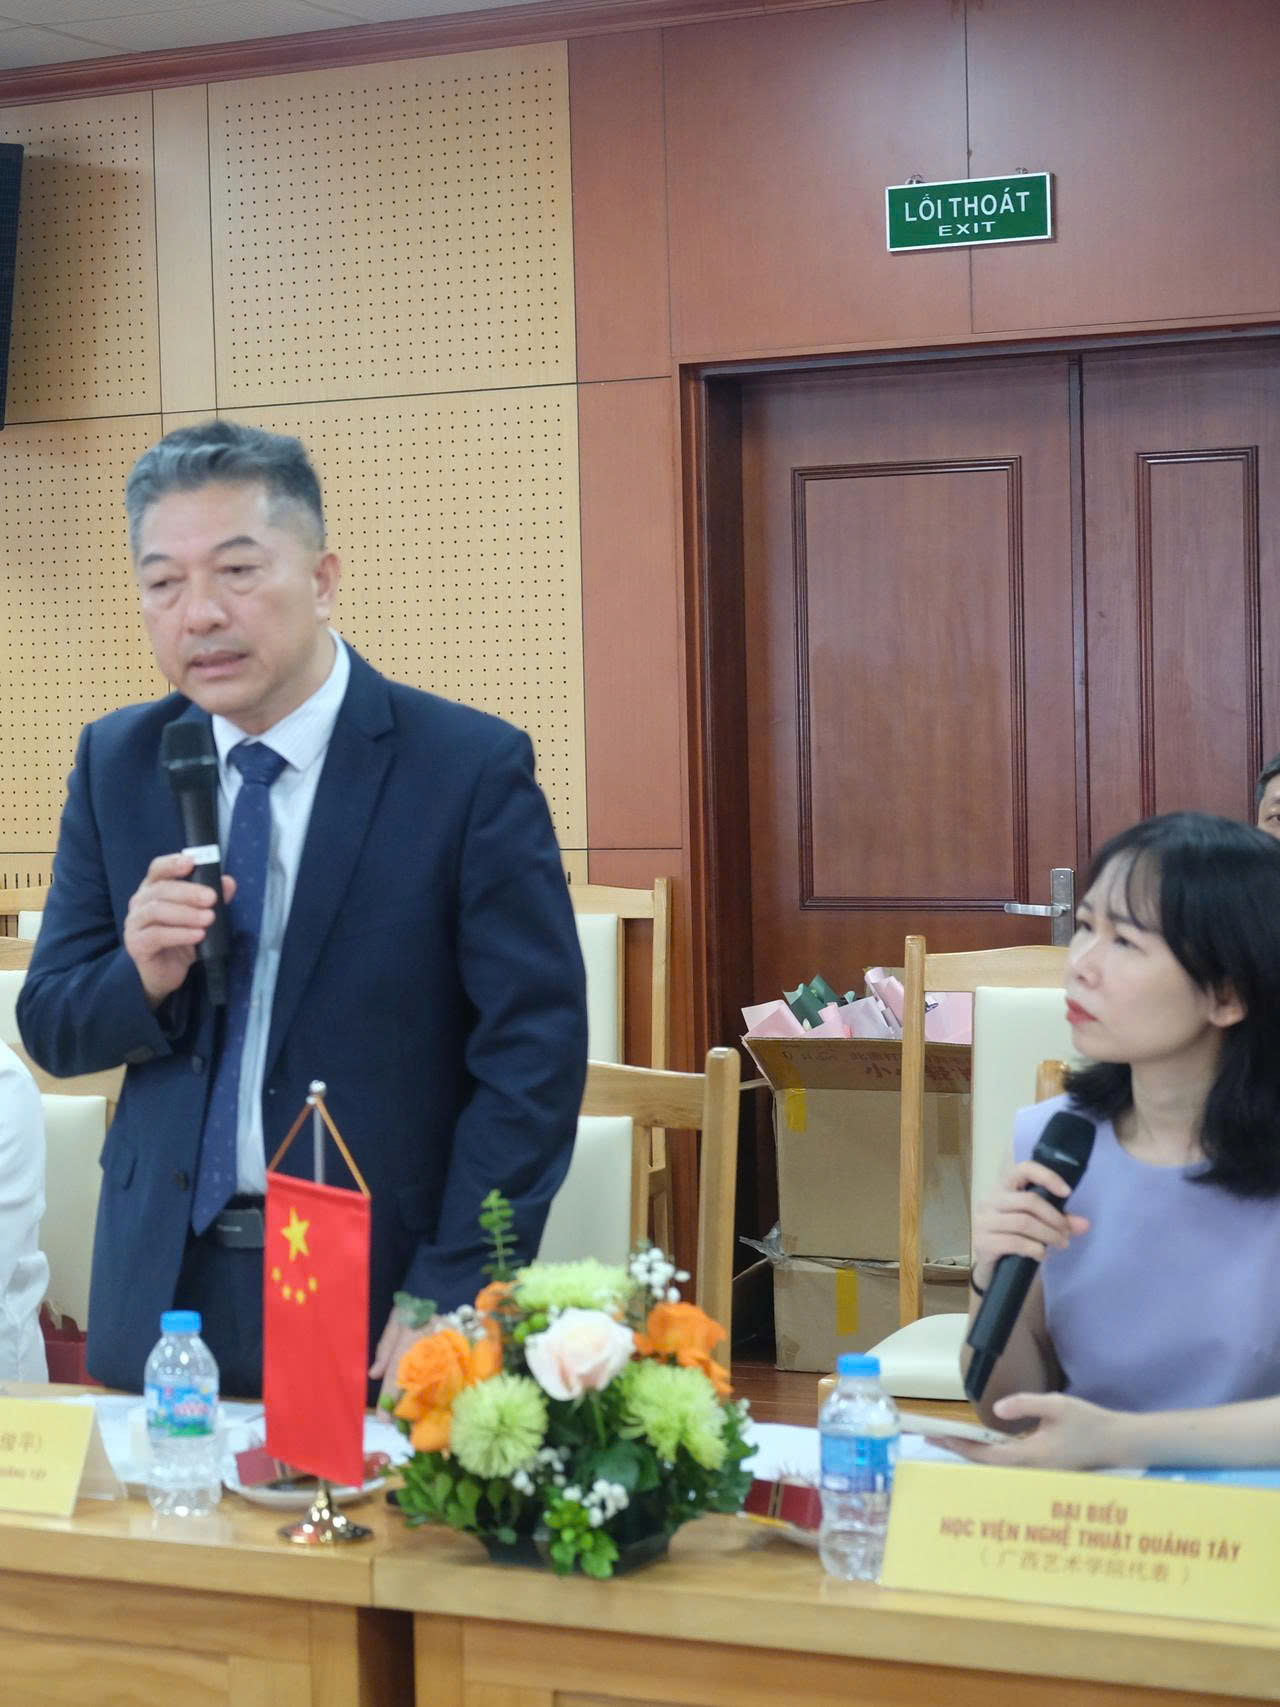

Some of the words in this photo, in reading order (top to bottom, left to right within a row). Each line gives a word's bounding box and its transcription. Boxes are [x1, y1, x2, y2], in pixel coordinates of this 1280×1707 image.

[905, 193, 942, 222] LỐI
[948, 187, 1031, 218] THOÁT
[938, 221, 996, 237] EXIT
